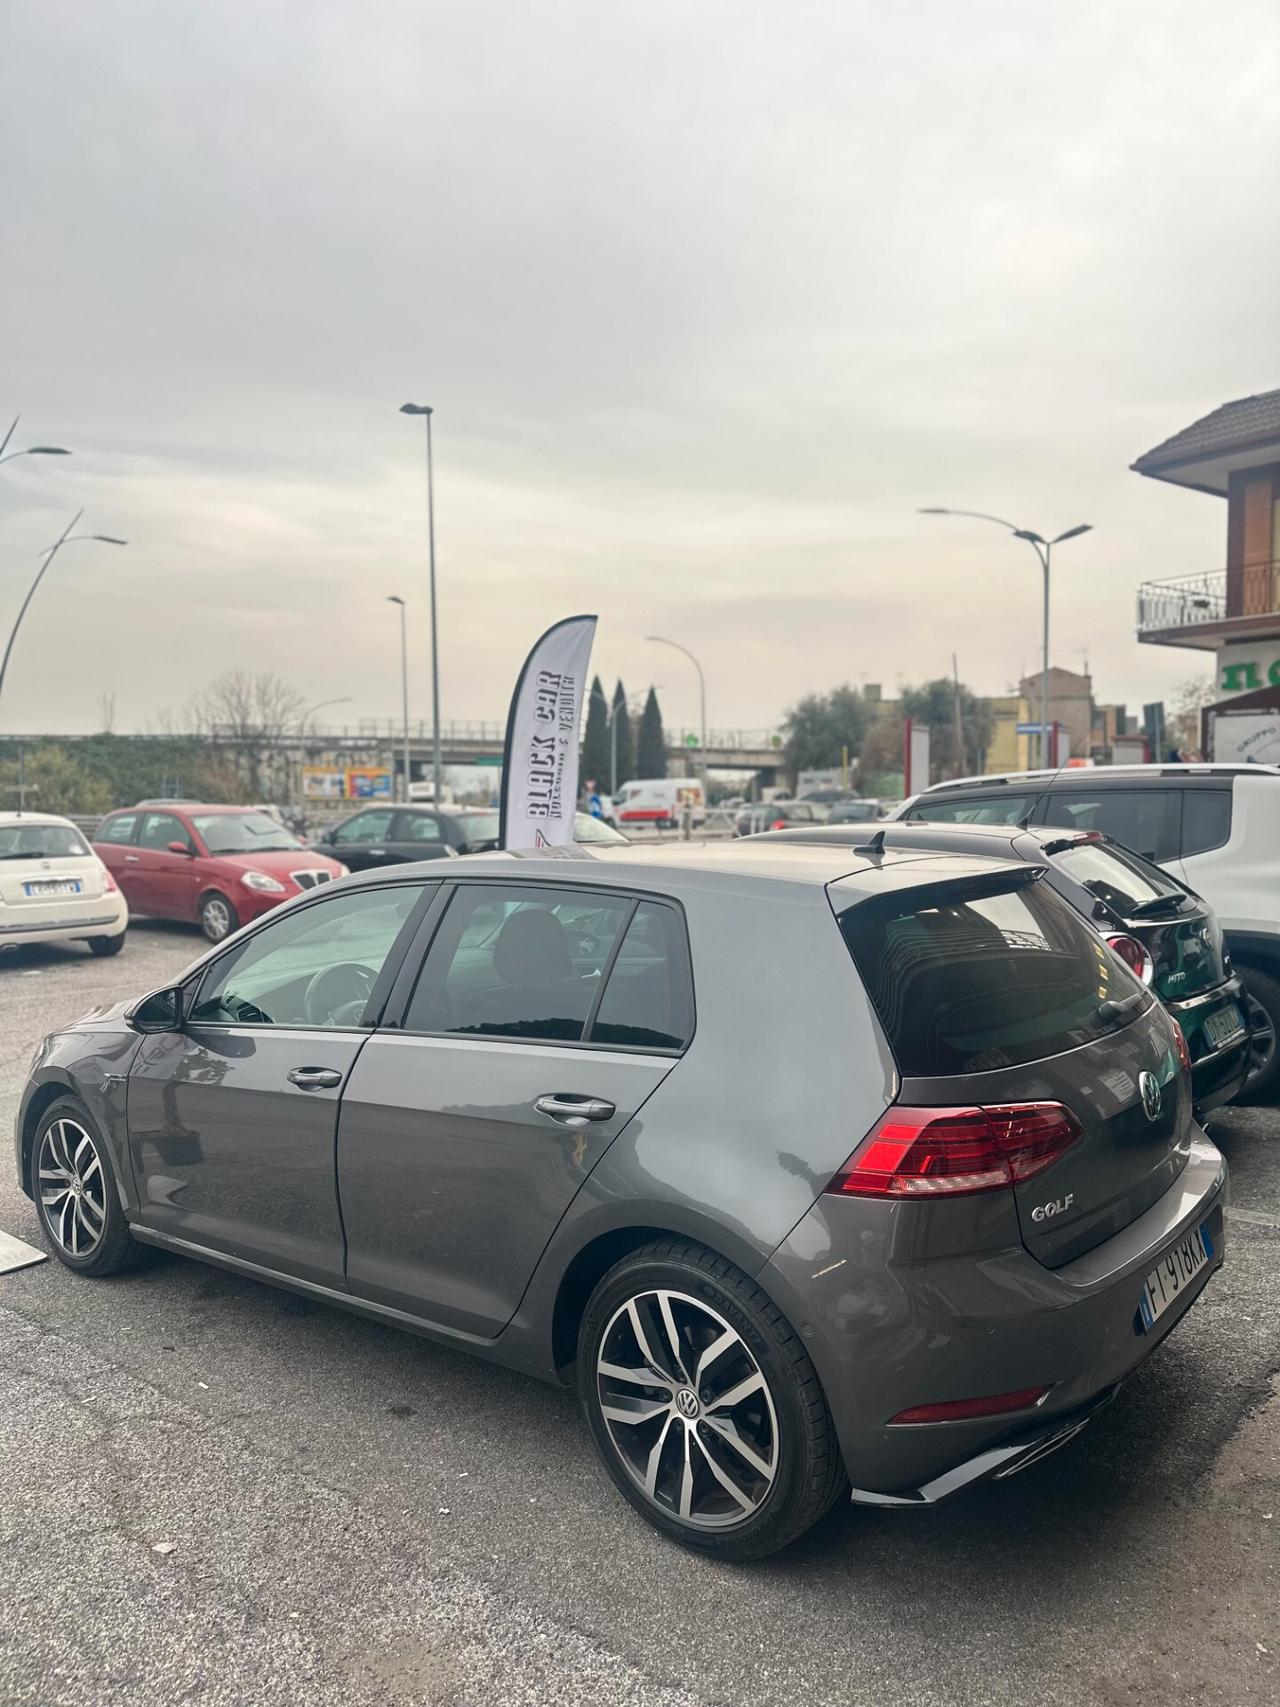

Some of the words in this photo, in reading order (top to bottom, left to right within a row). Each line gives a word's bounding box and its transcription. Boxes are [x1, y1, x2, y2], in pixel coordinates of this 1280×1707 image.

[536, 670, 562, 724] CAR
[526, 735, 556, 820] BLACK
[1031, 1193, 1074, 1222] GOLF
